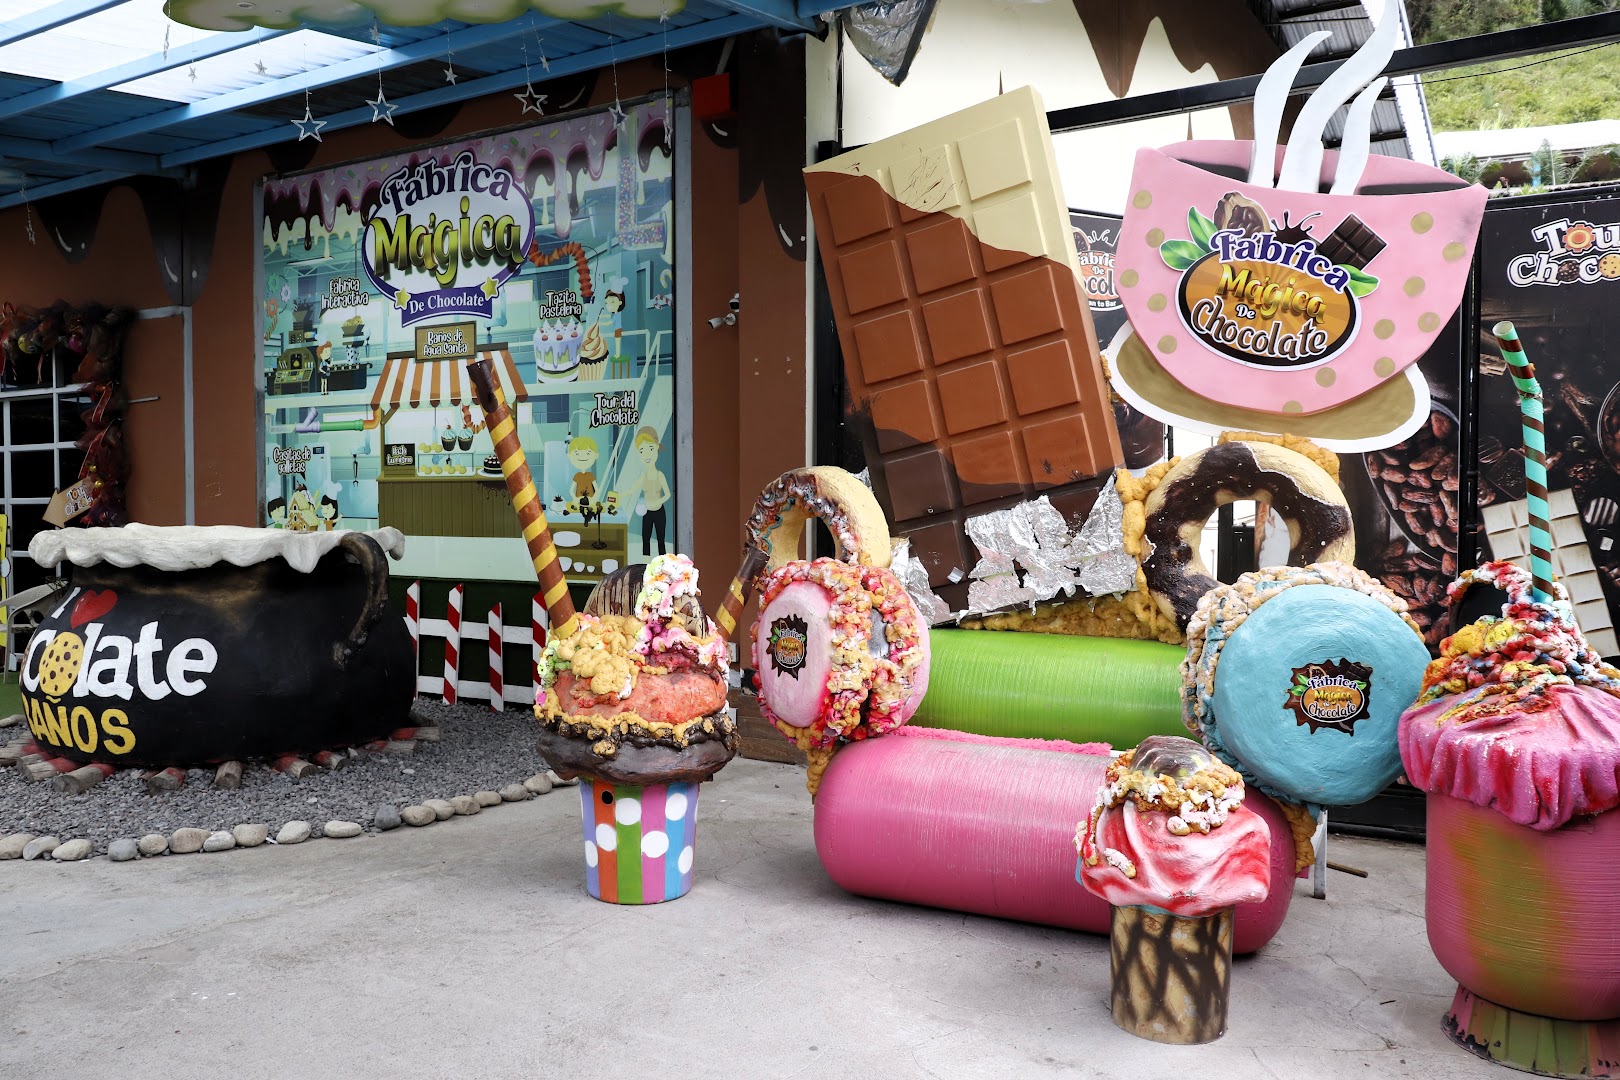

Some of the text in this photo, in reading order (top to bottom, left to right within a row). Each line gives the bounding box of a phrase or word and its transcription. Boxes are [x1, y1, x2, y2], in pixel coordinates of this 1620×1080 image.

[381, 151, 512, 215] Fábrica
[369, 195, 526, 286] Mágica
[1533, 219, 1620, 257] Tou
[1092, 266, 1105, 275] De
[1211, 228, 1351, 293] Fábrica
[1508, 253, 1620, 286] Choco
[321, 291, 369, 309] Interactiva
[410, 292, 485, 314] De Chocolate
[545, 289, 576, 307] Tazita
[1216, 263, 1327, 325] Mágica
[1236, 304, 1256, 320] De
[427, 328, 463, 346] Baños de
[1191, 295, 1328, 359] Chocolate
[423, 341, 468, 357] Agua Santa
[594, 391, 635, 411] Tour del
[591, 408, 639, 427] Chocolate
[273, 446, 311, 463] Casitas de
[51, 586, 81, 619] I
[1308, 701, 1356, 718] Chocolate
